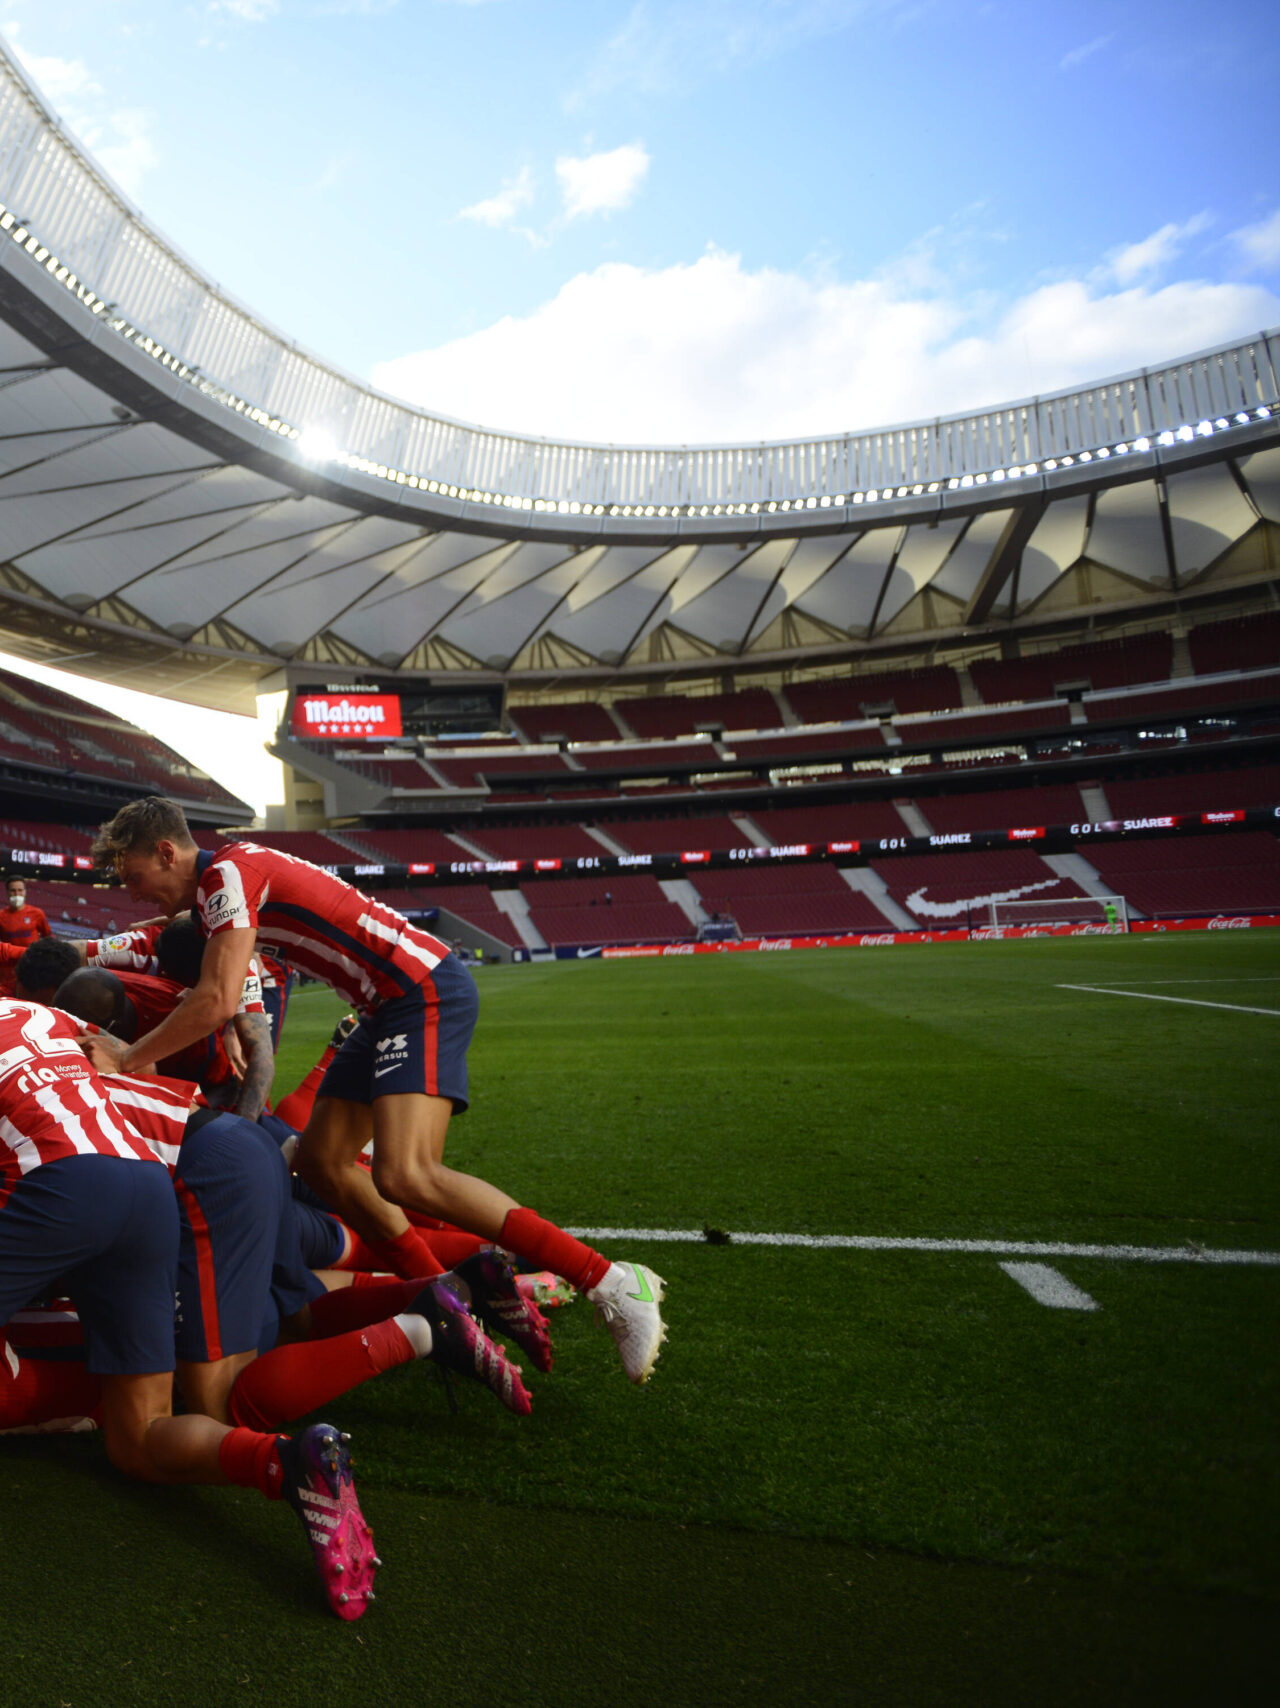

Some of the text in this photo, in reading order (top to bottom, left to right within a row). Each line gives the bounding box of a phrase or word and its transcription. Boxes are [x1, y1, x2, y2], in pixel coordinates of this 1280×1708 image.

[303, 700, 386, 723] Mahou
[1070, 822, 1102, 835] GOL
[879, 837, 907, 850] GOL
[11, 848, 29, 863] GOL
[729, 847, 754, 860] GOL
[576, 856, 600, 869] GOL
[17, 1063, 60, 1094] ria
